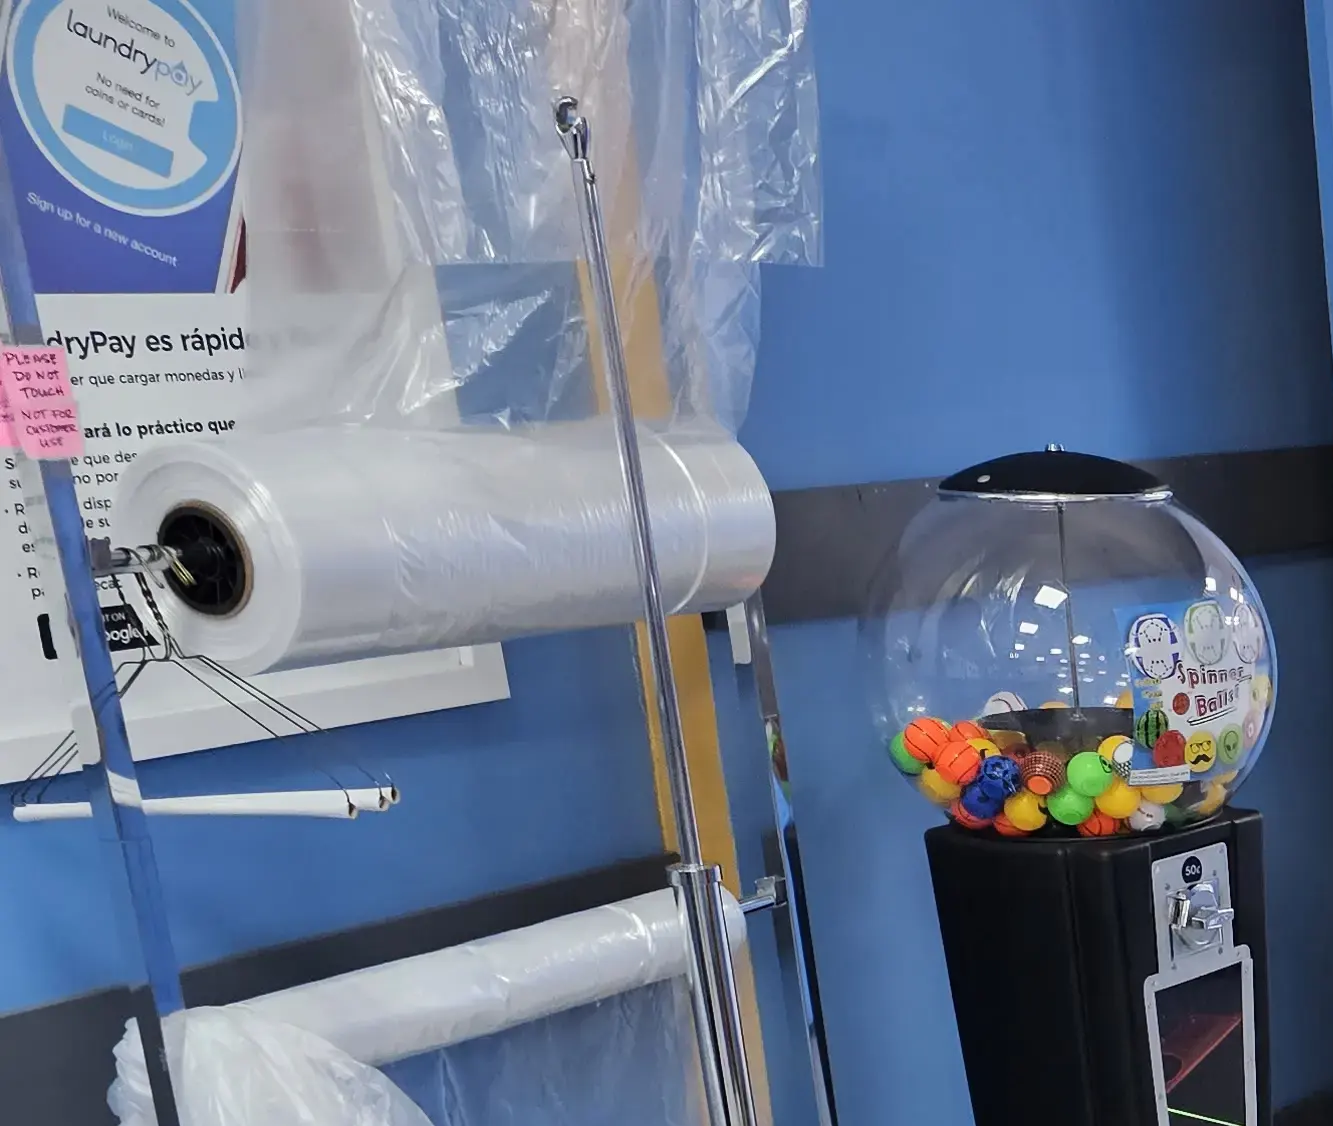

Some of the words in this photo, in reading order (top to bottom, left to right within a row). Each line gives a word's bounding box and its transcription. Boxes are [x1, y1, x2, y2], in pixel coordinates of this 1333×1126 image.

[106, 5, 161, 42] Welcome
[164, 34, 176, 48] to
[96, 71, 113, 88] No
[115, 80, 142, 102] need
[145, 94, 161, 109] for
[85, 84, 114, 105] coins
[118, 98, 130, 111] or
[132, 105, 167, 128] cards!
[102, 129, 134, 152] Login
[27, 191, 55, 213] Sign
[57, 207, 73, 222] up
[75, 213, 92, 229] for
[93, 222, 102, 234] a
[103, 226, 129, 246] new
[130, 237, 178, 267] account
[47, 330, 136, 360] dryPay
[146, 333, 173, 352] es
[181, 327, 246, 356] rápid
[3, 352, 57, 366] PLEASE
[12, 371, 31, 382] DO
[36, 369, 60, 380] NOT
[89, 373, 116, 388] que
[119, 371, 161, 387] cargar
[165, 366, 223, 383] monedas
[224, 370, 235, 383] y
[20, 384, 65, 399] TOUCH
[21, 408, 47, 420] NOT
[116, 421, 132, 437] lo
[137, 418, 203, 440] práctico
[83, 453, 111, 468] que
[111, 612, 126, 621] ON
[1177, 660, 1244, 689] Spinner
[1195, 684, 1240, 716] Balls!
